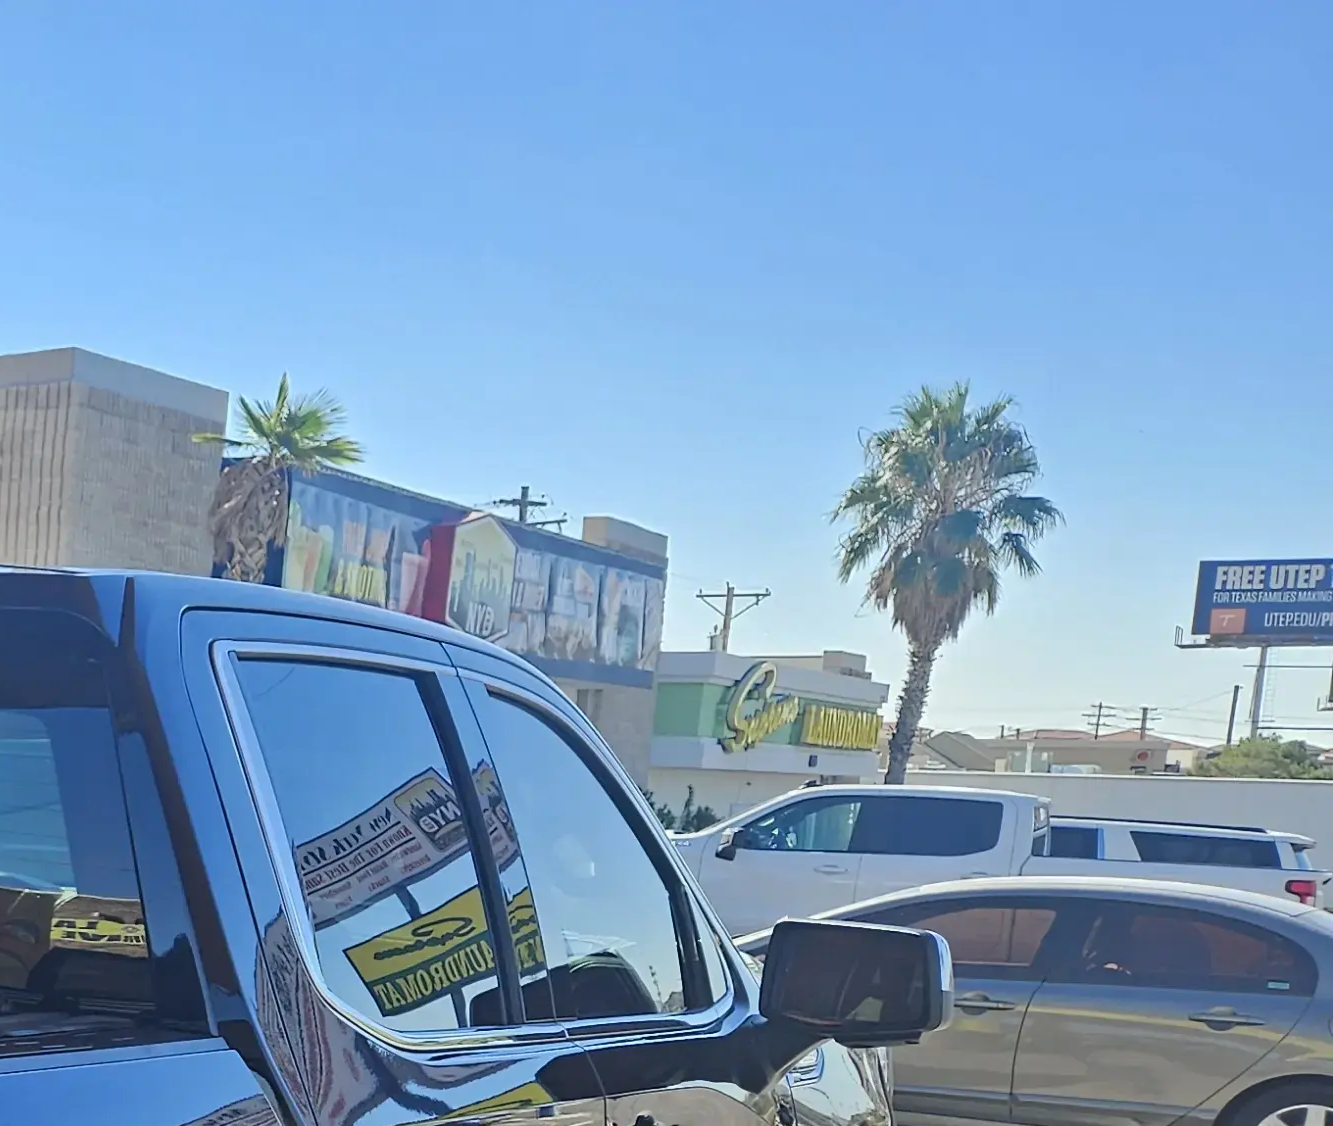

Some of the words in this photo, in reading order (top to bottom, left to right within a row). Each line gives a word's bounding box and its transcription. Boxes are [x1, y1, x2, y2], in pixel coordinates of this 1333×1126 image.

[1214, 565, 1266, 590] FREE
[1269, 564, 1326, 589] UTEP
[1213, 592, 1229, 603] FOR
[1231, 591, 1258, 603] TEXAS
[1258, 591, 1296, 603] FAMILIES
[1297, 590, 1332, 602] MAKING
